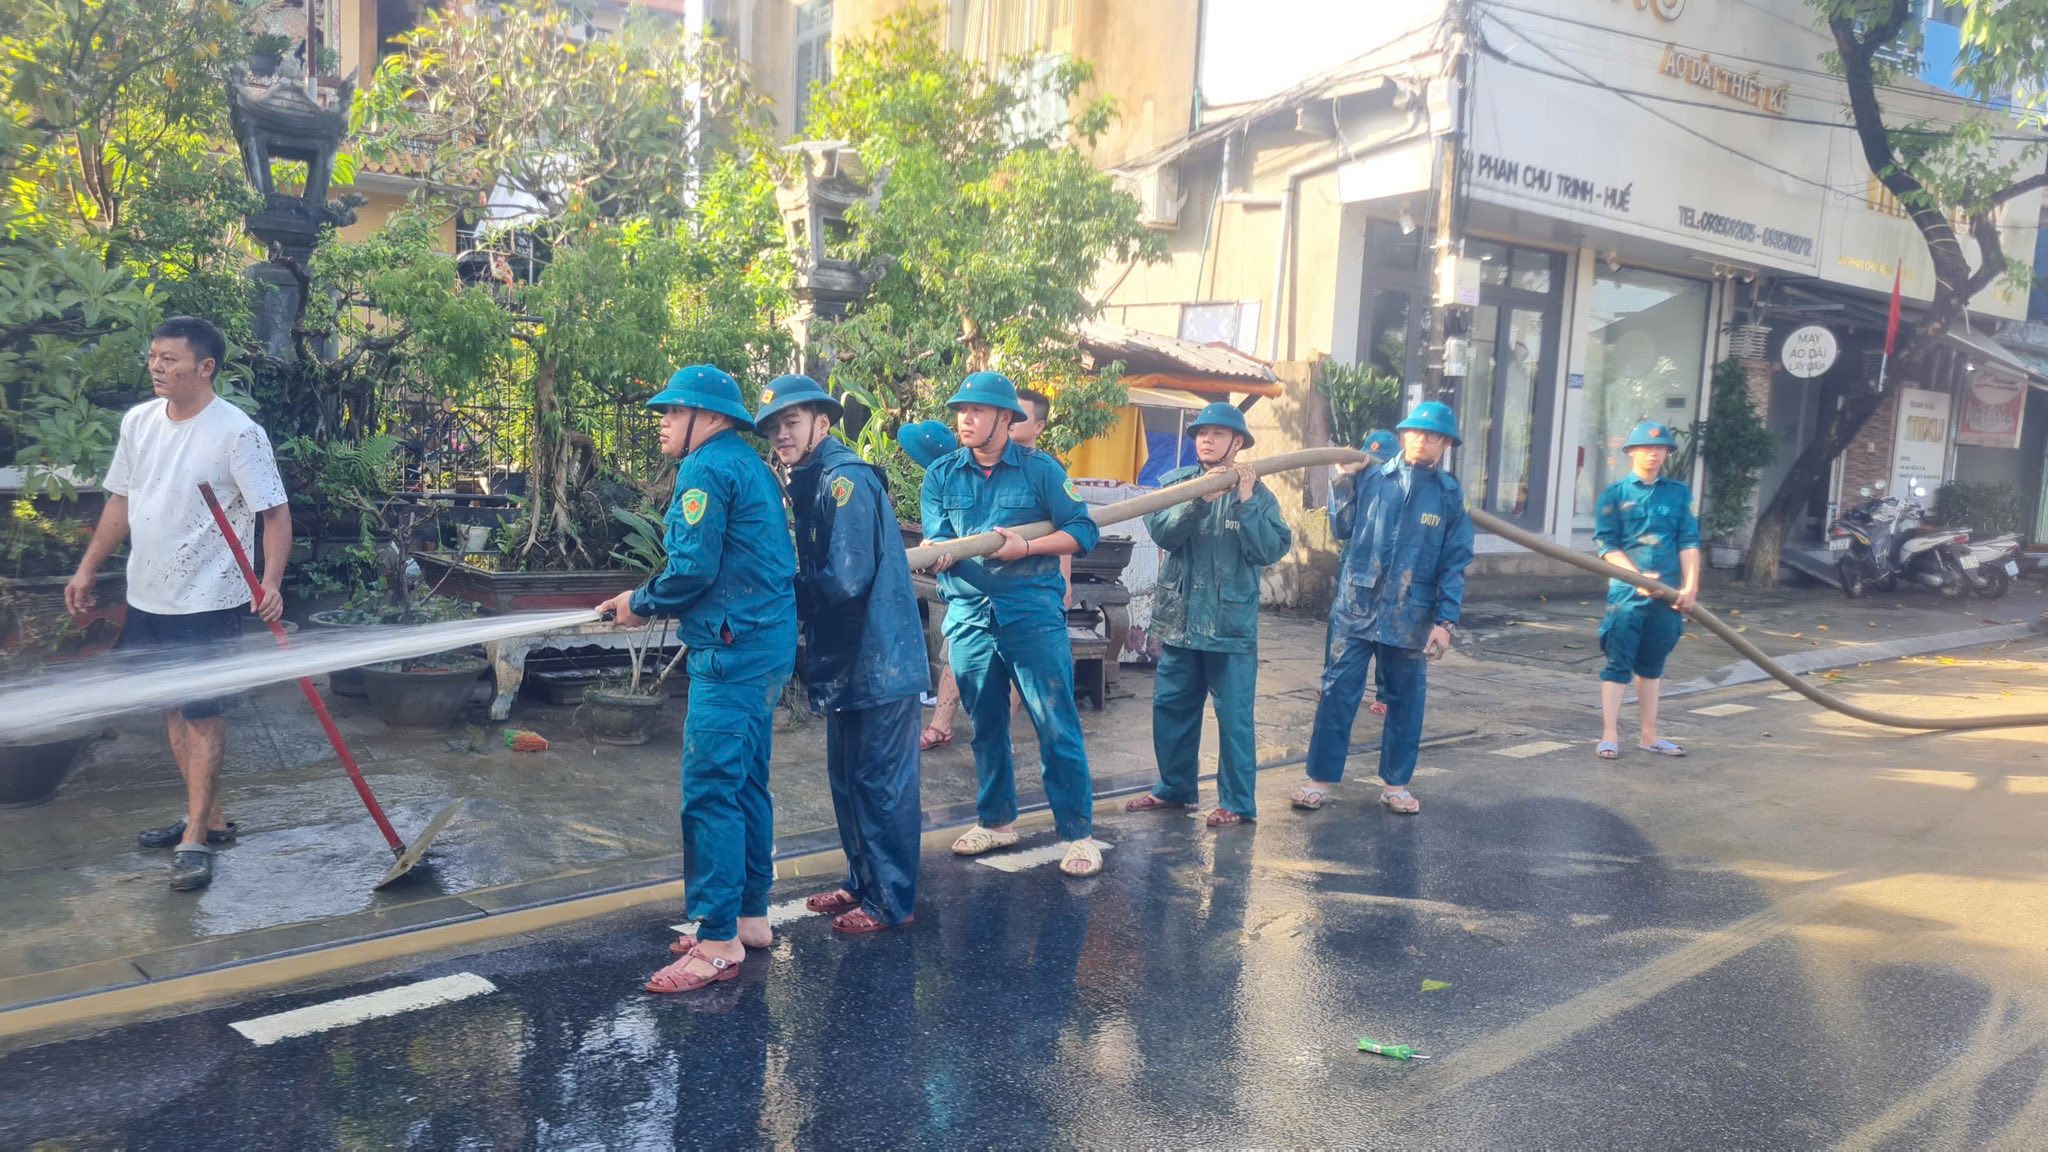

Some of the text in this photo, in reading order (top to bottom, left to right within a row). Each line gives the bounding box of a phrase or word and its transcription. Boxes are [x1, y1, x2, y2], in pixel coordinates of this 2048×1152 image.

[1478, 153, 1519, 186] PHAN
[1523, 165, 1552, 193] CHU
[1556, 173, 1595, 204] TRINH
[1798, 334, 1822, 345] MAY
